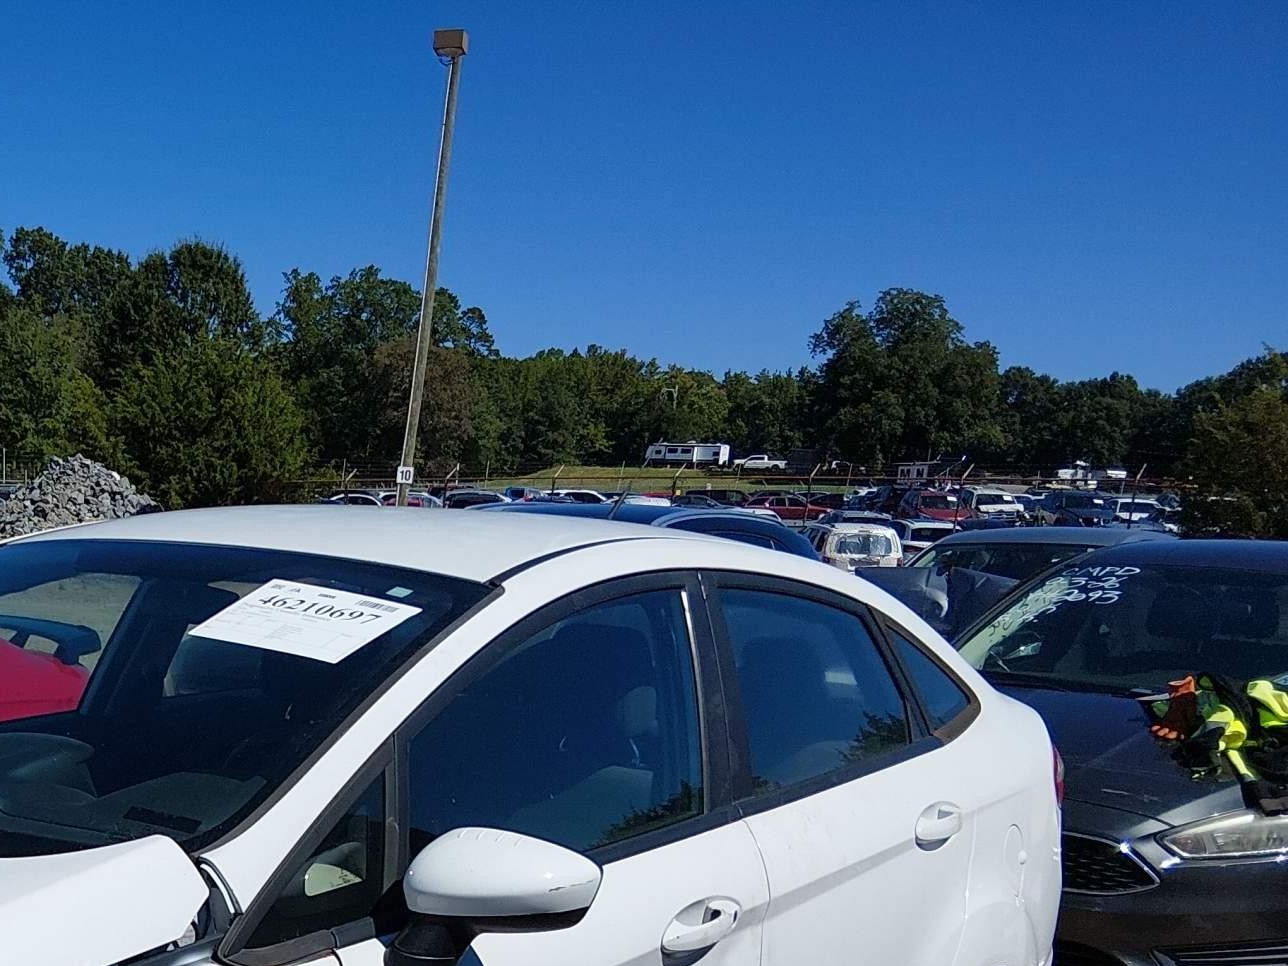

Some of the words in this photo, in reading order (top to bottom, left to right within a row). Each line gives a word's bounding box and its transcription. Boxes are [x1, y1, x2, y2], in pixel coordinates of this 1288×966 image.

[399, 469, 412, 482] 10
[1062, 566, 1141, 577] CMPD
[258, 593, 384, 625] 46210697
